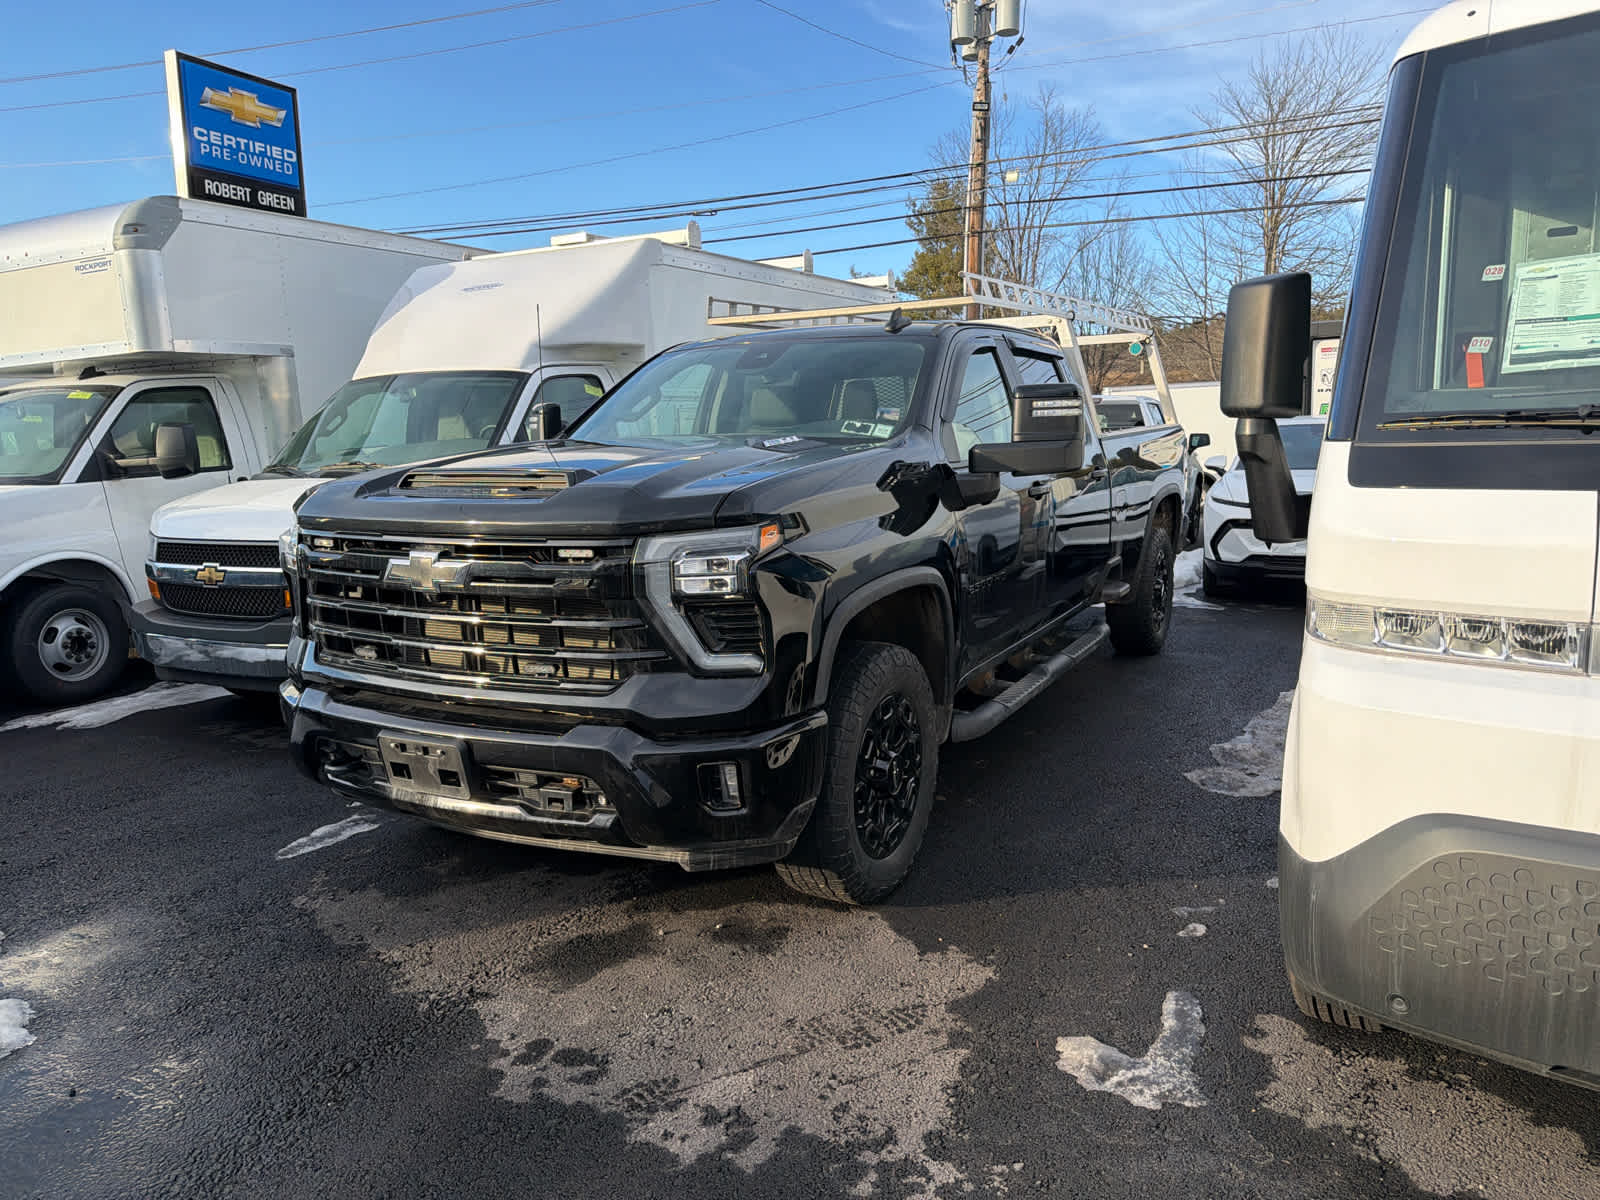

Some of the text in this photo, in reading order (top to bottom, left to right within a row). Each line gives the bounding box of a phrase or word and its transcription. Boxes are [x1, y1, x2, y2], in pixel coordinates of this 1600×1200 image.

[193, 126, 297, 163] CERTIFIED
[200, 143, 293, 175] PRE-OWNED
[204, 179, 295, 211] ROBERT GREEN
[74, 260, 113, 272] ROCKPORT
